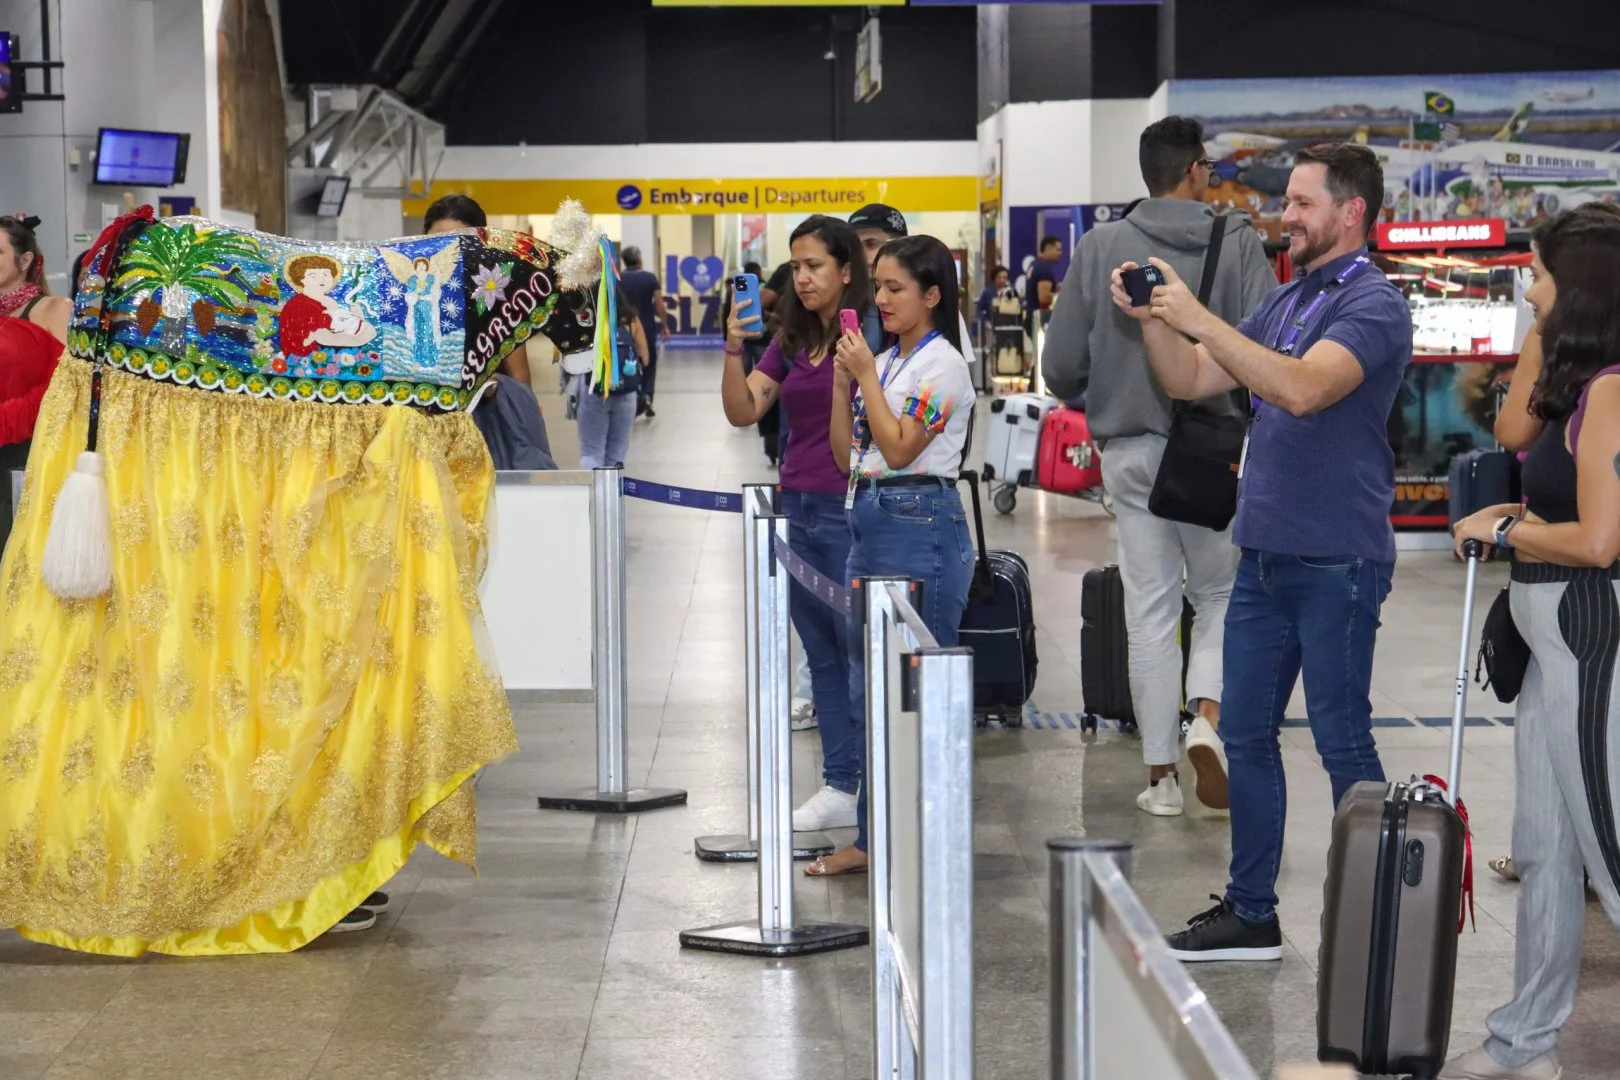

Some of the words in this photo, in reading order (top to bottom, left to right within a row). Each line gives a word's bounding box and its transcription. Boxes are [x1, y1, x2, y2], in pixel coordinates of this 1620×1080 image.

[650, 188, 749, 208] Embarque
[765, 187, 866, 207] Departures
[461, 271, 552, 390] SEGREDO
